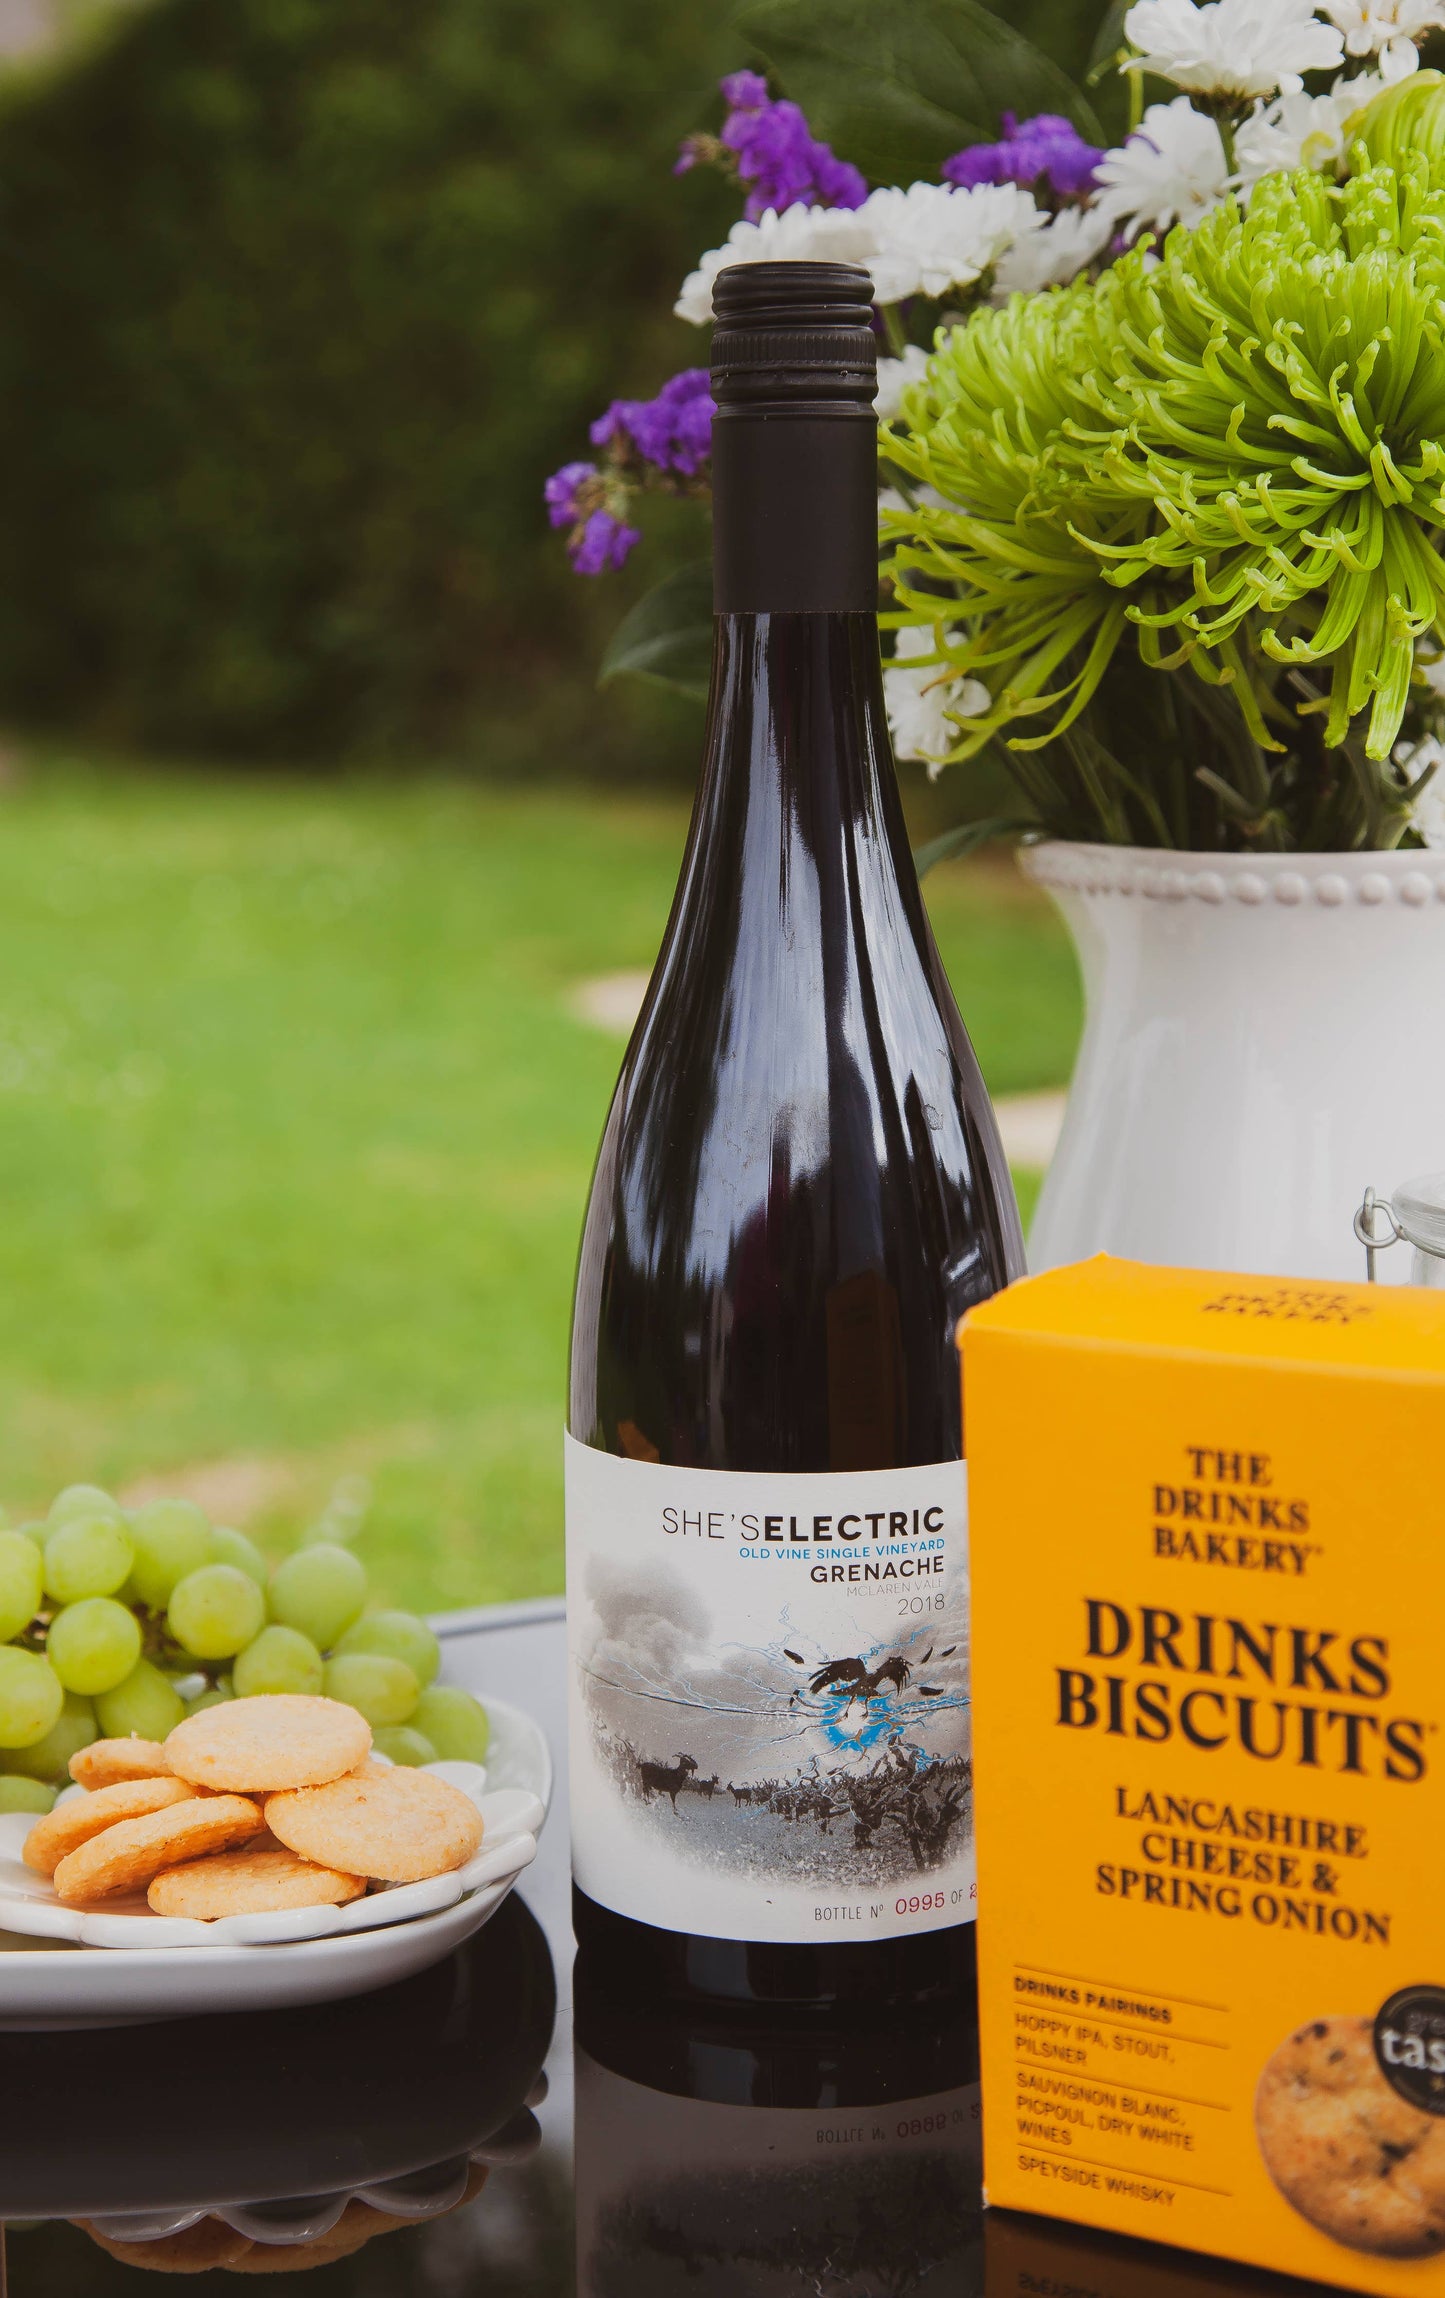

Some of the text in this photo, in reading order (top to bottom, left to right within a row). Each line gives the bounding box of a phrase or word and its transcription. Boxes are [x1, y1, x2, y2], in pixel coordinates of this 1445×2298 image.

[1186, 1445, 1273, 1487] THE
[1153, 1483, 1310, 1535] DRINKS
[739, 1538, 945, 1560] OLD VINE SINGLE VINEYARD
[810, 1555, 945, 1583] GRENACHE
[846, 1582, 911, 1597] MCLAREN
[898, 1593, 945, 1616] 2018
[1083, 1597, 1392, 1700] DRINKS
[1054, 1667, 1428, 1785] BISCUITS
[1115, 1785, 1370, 1860] LANCASHIRE
[1141, 1831, 1339, 1896] CHEESE &
[814, 1906, 862, 1921] BOTTLE
[895, 1891, 945, 1915] 0995
[950, 1888, 964, 1905] OF
[1096, 1863, 1392, 1947] SPRING ONION
[1014, 1976, 1172, 2025] DRINKS PAIRINGS
[1015, 2012, 1072, 2038] HOPPY
[1016, 2035, 1087, 2066] PILSNER
[1016, 2072, 1117, 2109] SAUVIGNON
[1017, 2118, 1073, 2146] WINES
[1099, 2115, 1134, 2137] DRY
[1139, 2124, 1195, 2152] WHITE
[1017, 2154, 1176, 2207] SPEYSIDE WHISKY
